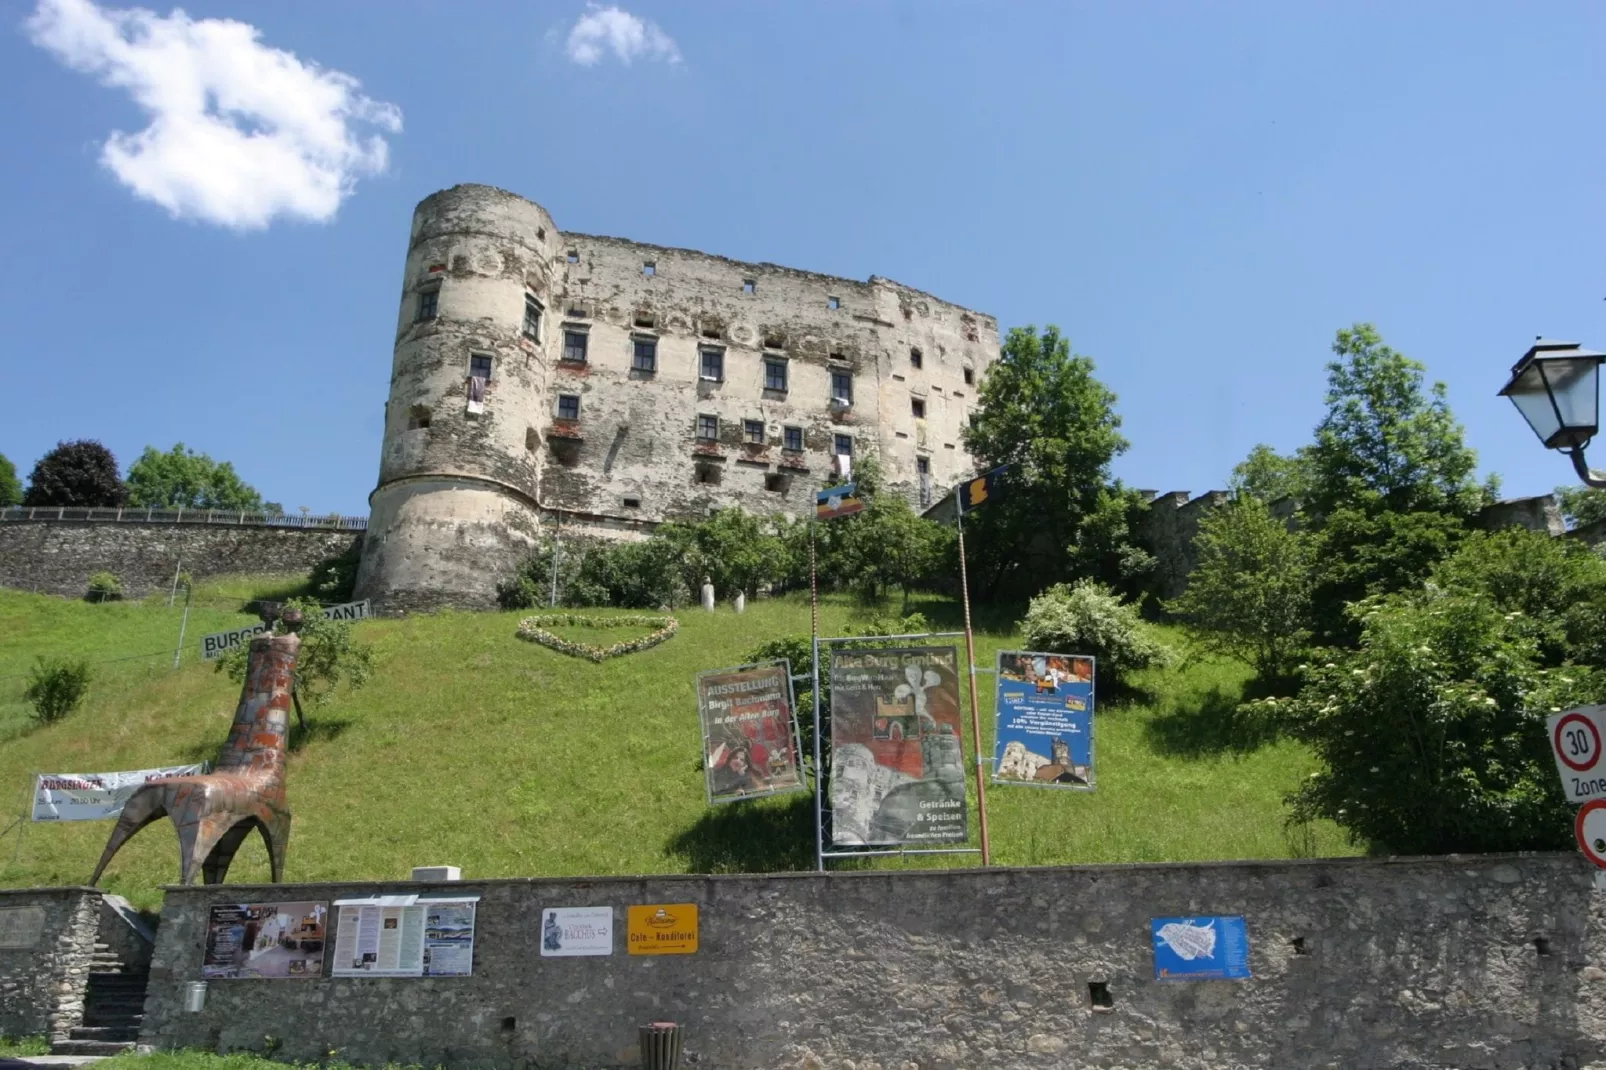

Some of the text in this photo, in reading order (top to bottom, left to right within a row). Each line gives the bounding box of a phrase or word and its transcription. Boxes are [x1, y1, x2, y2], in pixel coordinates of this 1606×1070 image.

[834, 651, 954, 670] Alte Burg Gmünd
[707, 676, 779, 697] AUSSTELLUNG
[708, 699, 733, 710] Birgit
[1566, 728, 1589, 756] 30
[1572, 777, 1606, 797] Zone
[919, 798, 961, 809] Getränke
[916, 812, 962, 823] & Speisen
[656, 930, 695, 941] Konditorei
